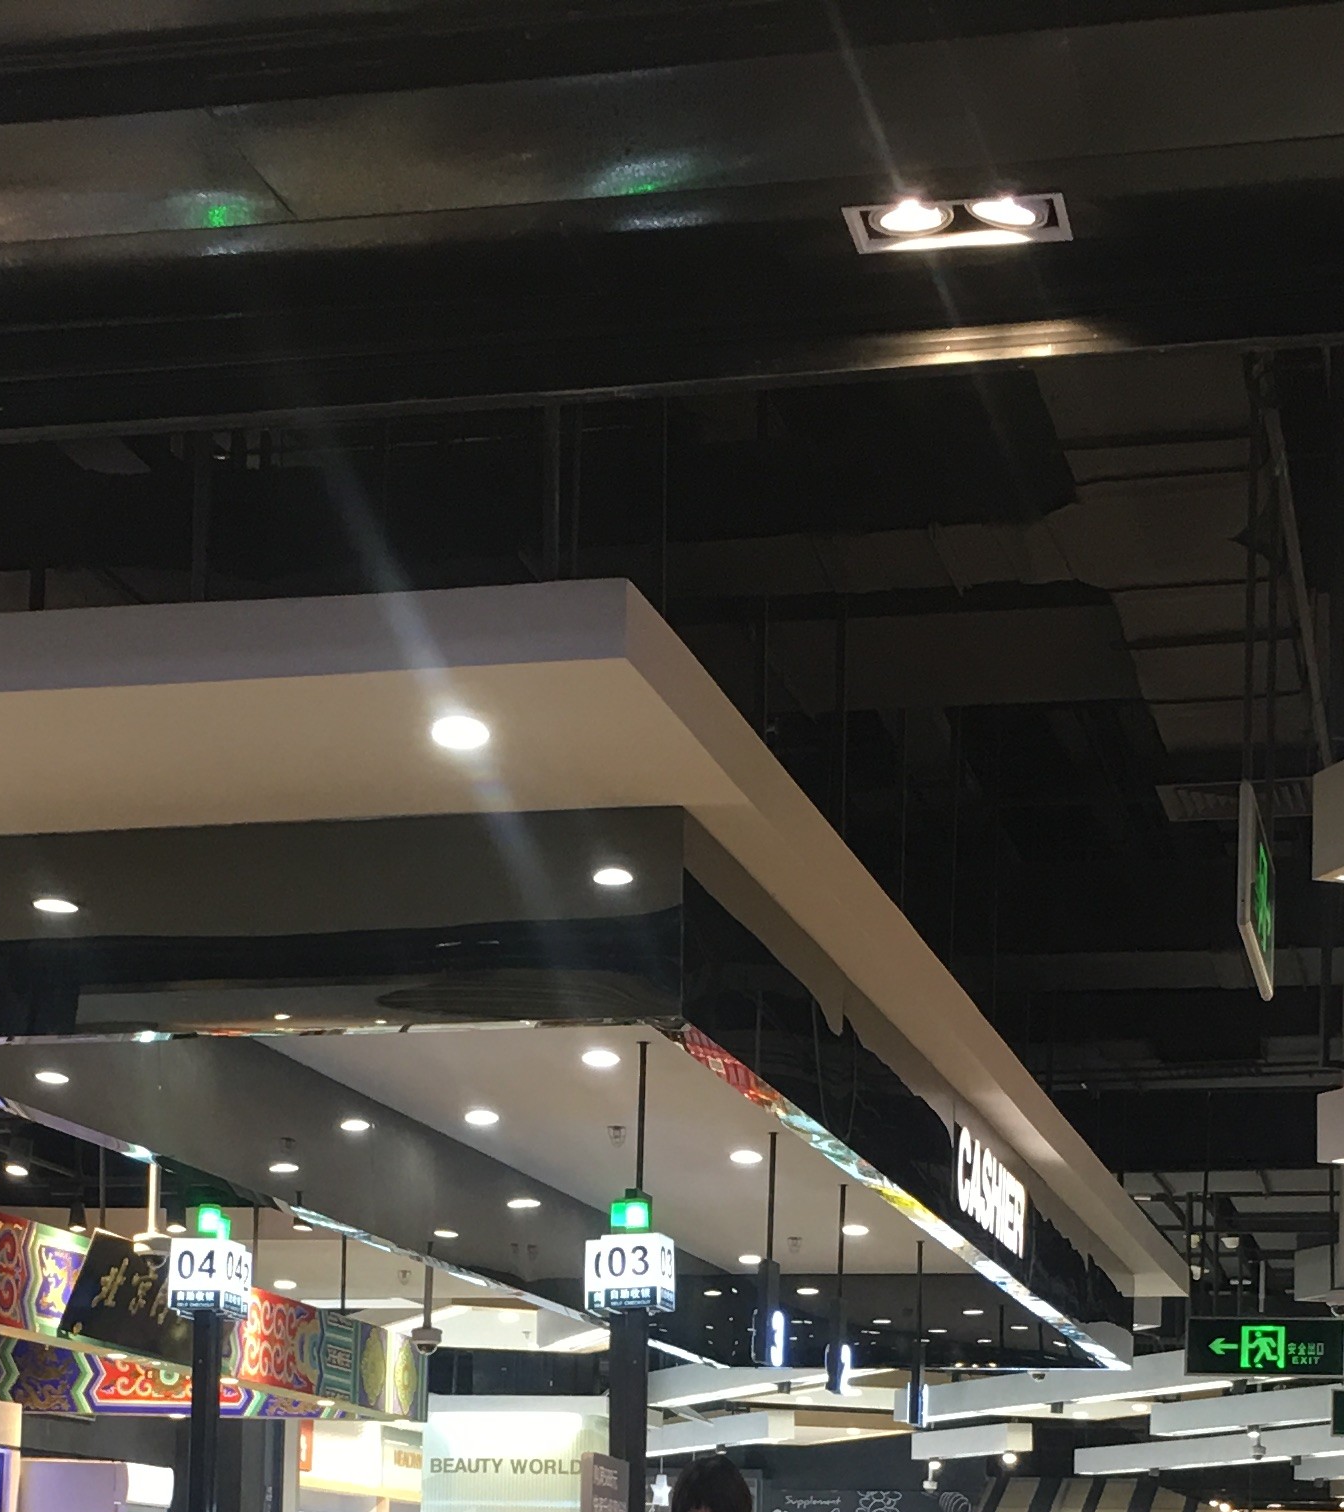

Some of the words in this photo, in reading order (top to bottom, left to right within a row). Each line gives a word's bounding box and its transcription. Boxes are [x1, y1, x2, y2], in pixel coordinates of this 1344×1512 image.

[957, 1126, 1025, 1260] CASHIER
[177, 1250, 216, 1280] 04
[226, 1251, 243, 1281] 04
[608, 1245, 650, 1277] 03
[1287, 1342, 1325, 1356] 安全出口
[1291, 1356, 1321, 1365] EXIT
[430, 1457, 503, 1474] BEAUTY
[510, 1458, 582, 1476] WORLD
[784, 1495, 842, 1509] Supplement
